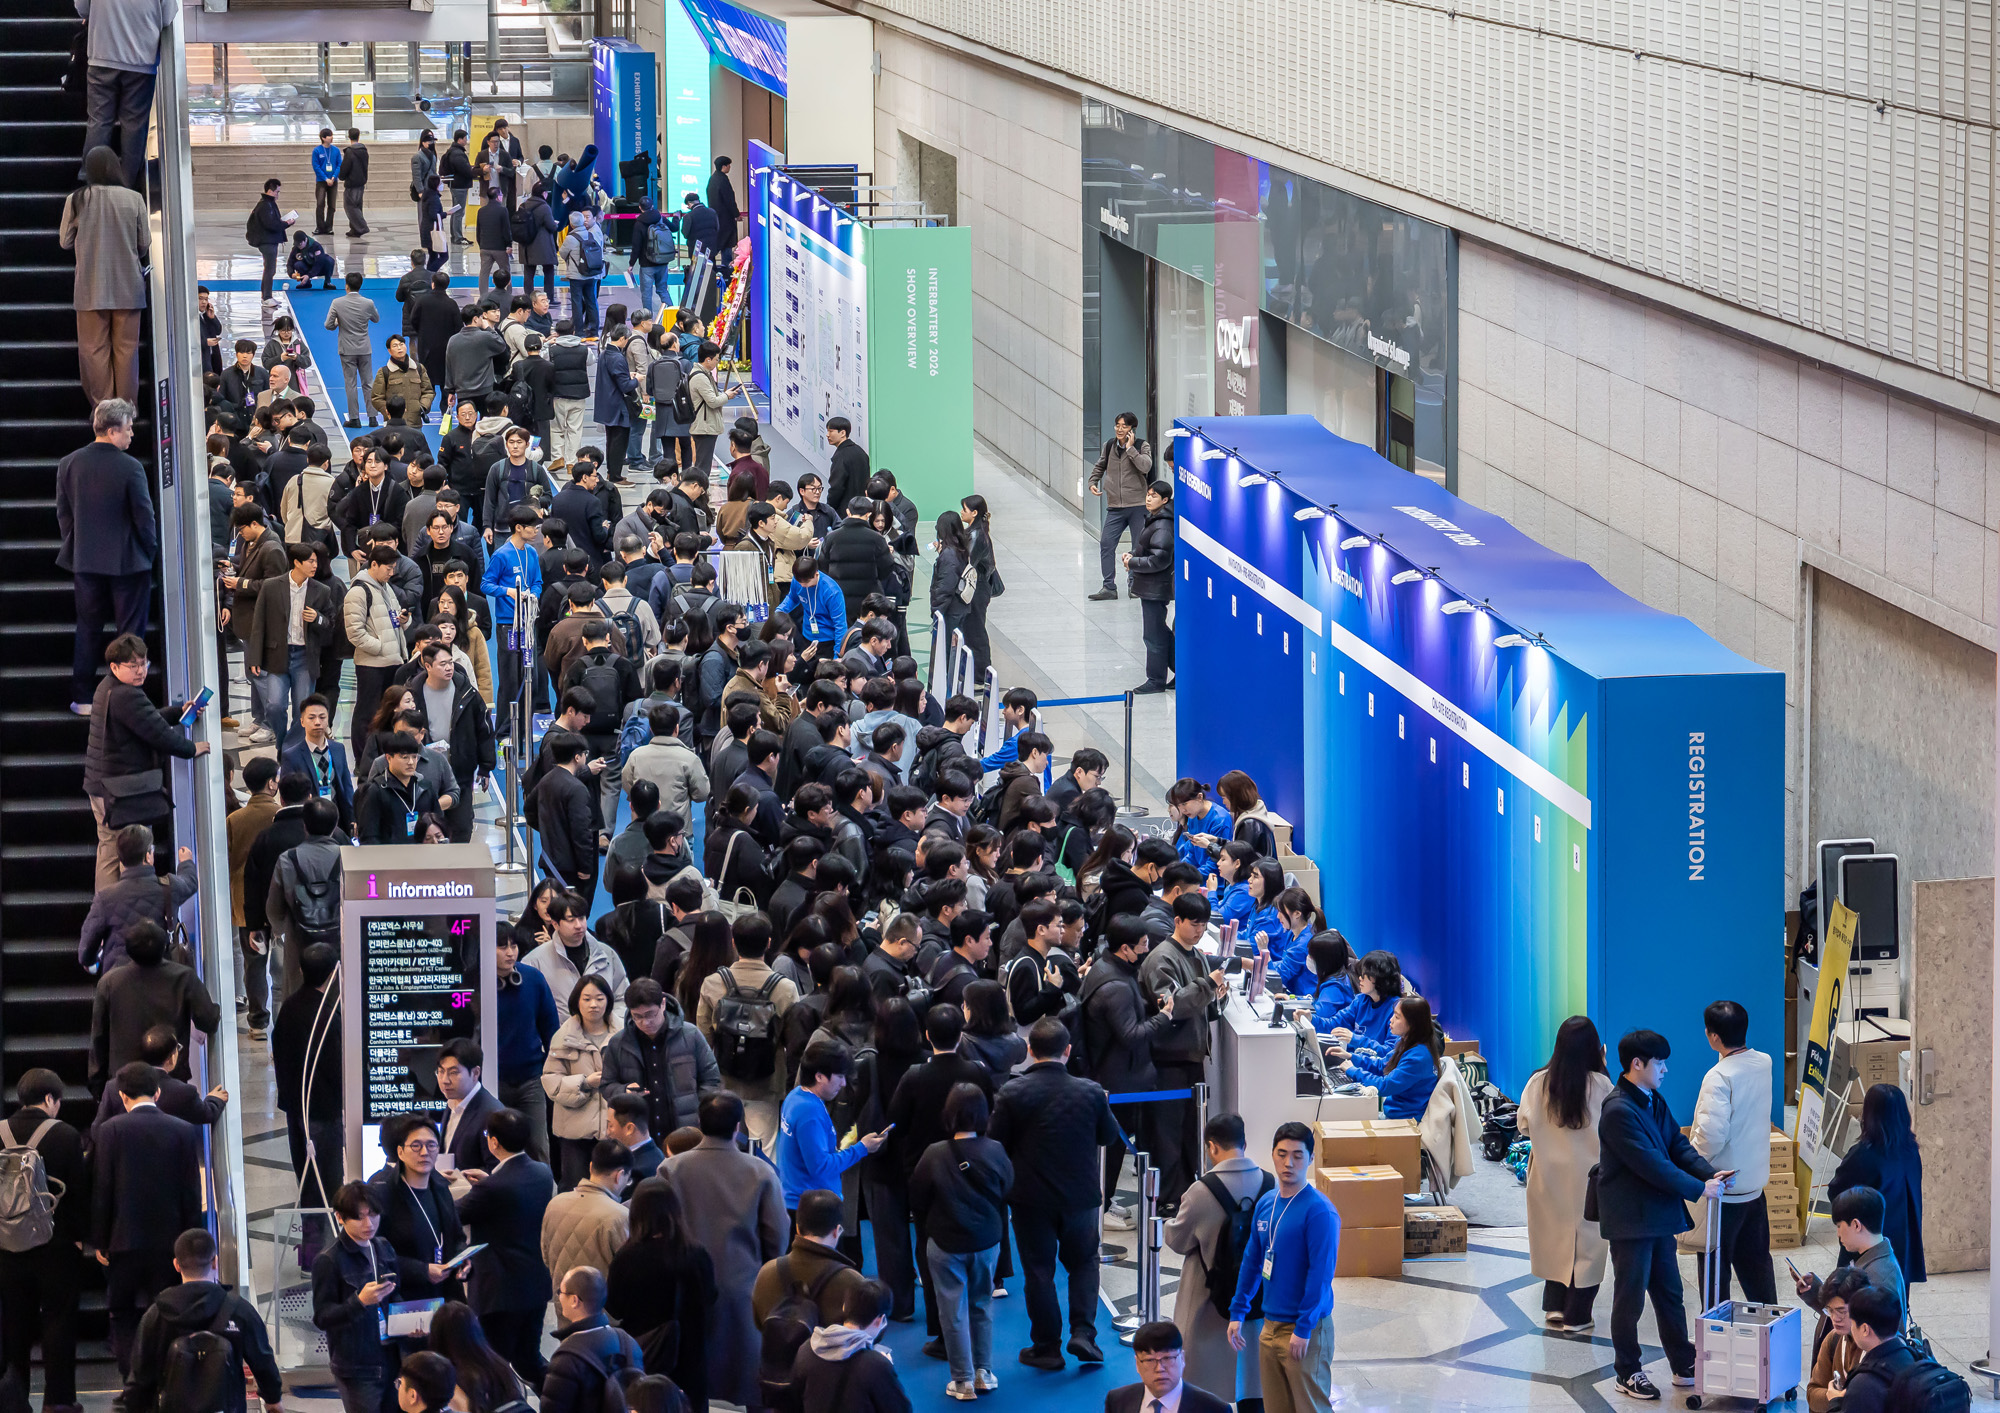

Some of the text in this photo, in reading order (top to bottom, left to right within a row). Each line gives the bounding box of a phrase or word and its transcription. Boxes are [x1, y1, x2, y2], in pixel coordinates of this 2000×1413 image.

[634, 131, 642, 153] REGIS
[906, 268, 917, 369] SHOW OVERVIEW
[928, 267, 939, 377] INTERBATTERY 2026
[1217, 316, 1252, 369] coex
[1688, 731, 1705, 881] REGISTRATION
[388, 882, 473, 898] information
[402, 920, 424, 931] 사무실
[451, 919, 472, 936] 4F
[368, 957, 411, 967] 무역아카데미
[418, 956, 444, 966] ICT센터
[399, 966, 422, 974] Academy
[368, 974, 462, 985] 한국무역협회 일자리지원센터
[400, 984, 433, 992] Employment
[368, 994, 398, 1004] 전시홀 C
[451, 992, 472, 1009] 3F
[369, 1030, 412, 1040] 컨퍼런스룸 E
[369, 1048, 398, 1057] 더플라츠
[369, 1066, 409, 1075] 스튜디오159
[369, 1083, 415, 1093] 바이킹스 워프
[370, 1101, 413, 1111] 한국무역협회
